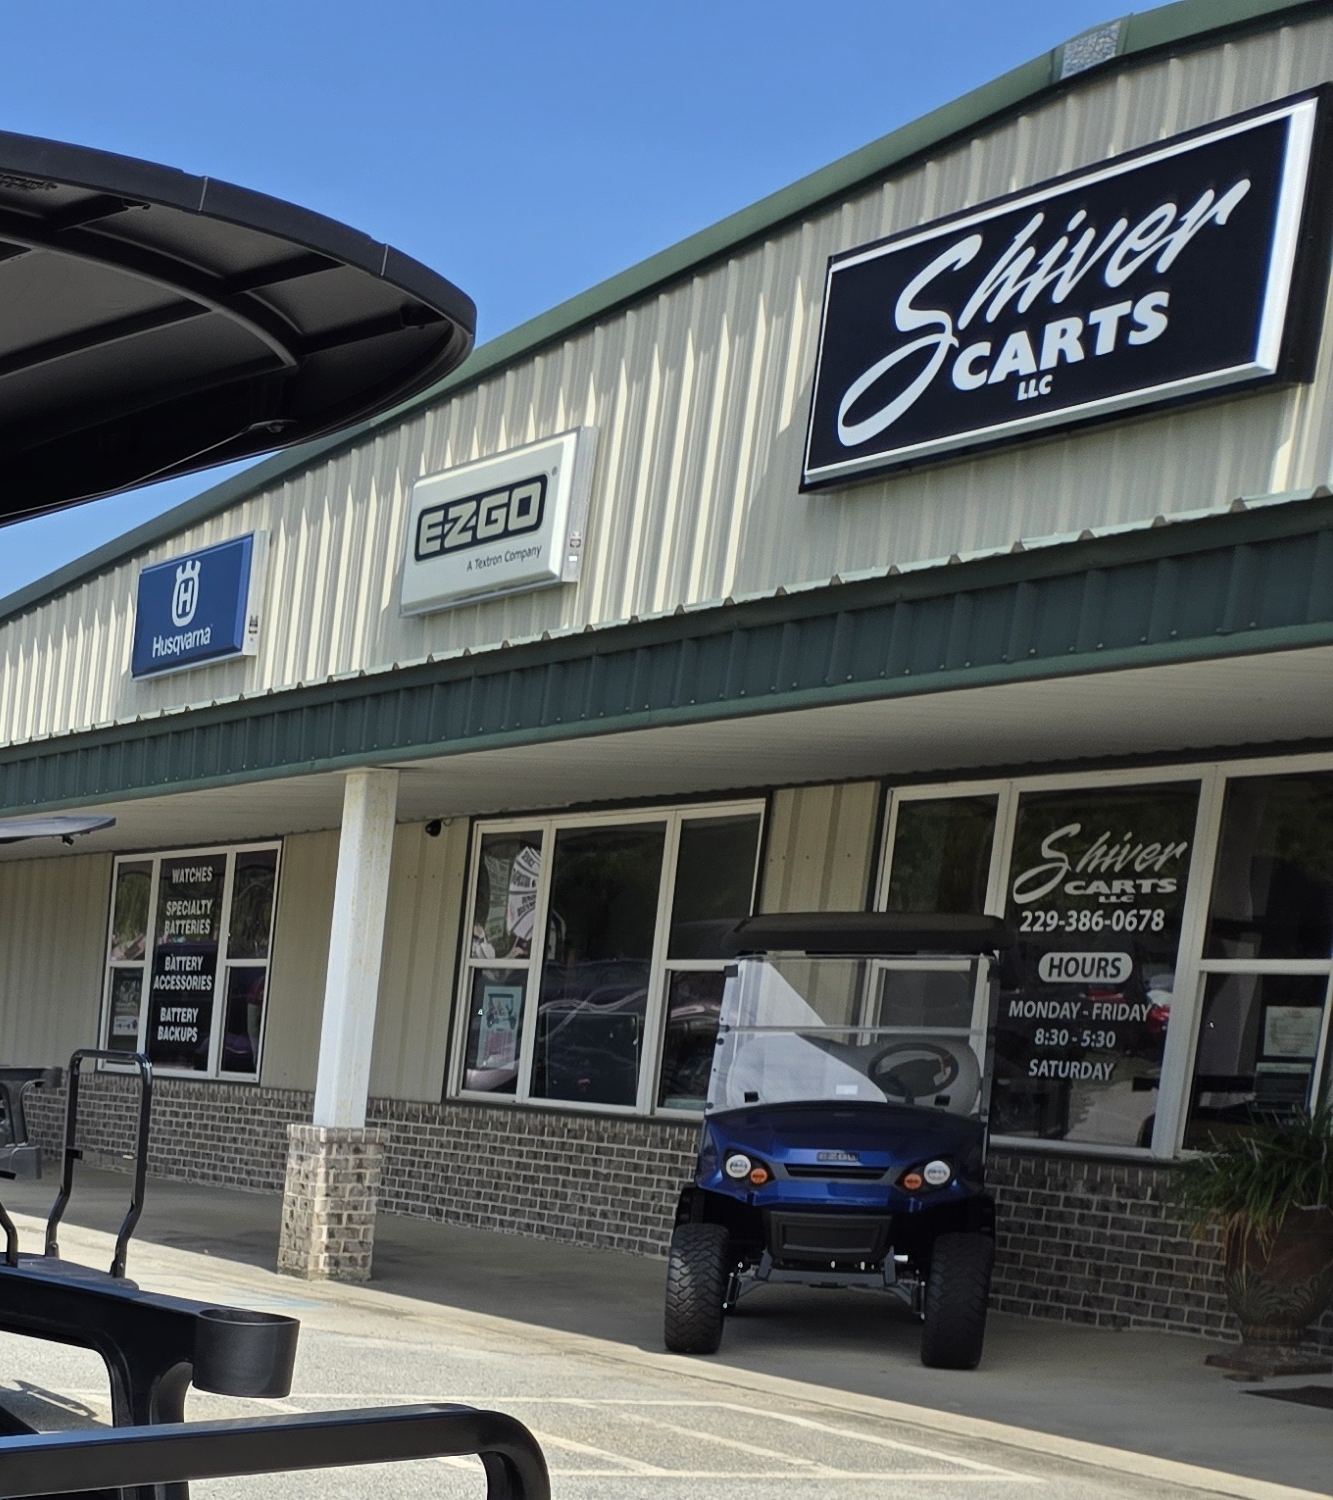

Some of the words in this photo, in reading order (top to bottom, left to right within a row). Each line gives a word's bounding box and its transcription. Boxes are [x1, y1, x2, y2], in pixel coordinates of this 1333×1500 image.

[837, 178, 1251, 447] Shiver
[951, 291, 1170, 391] CARTS
[1017, 375, 1052, 401] LLC
[419, 480, 542, 555] EZGO
[466, 560, 473, 571] A
[475, 554, 503, 570] Textron
[504, 545, 542, 562] Company
[152, 626, 212, 658] Husqvarna
[1013, 822, 1188, 904] Shiver
[172, 866, 213, 883] WATCHES
[1064, 878, 1177, 895] CARTS
[165, 900, 213, 916] SPECIALTY
[1098, 894, 1135, 903] LLC
[164, 919, 211, 935] BATTERIES
[1019, 910, 1165, 932] 229-386-0678
[164, 956, 203, 971] BATTERY
[1048, 956, 1122, 979] HOURS
[153, 975, 213, 990] ACCESSORIES
[160, 1007, 199, 1022] BATTERY
[1008, 1000, 1082, 1019] MONDAY
[1092, 1003, 1152, 1022] FRIDAY
[157, 1025, 198, 1042] BACKUPS
[1034, 1029, 1068, 1046] 8:30
[1081, 1030, 1116, 1048] 5:30
[1028, 1059, 1114, 1080] SATURDAY
